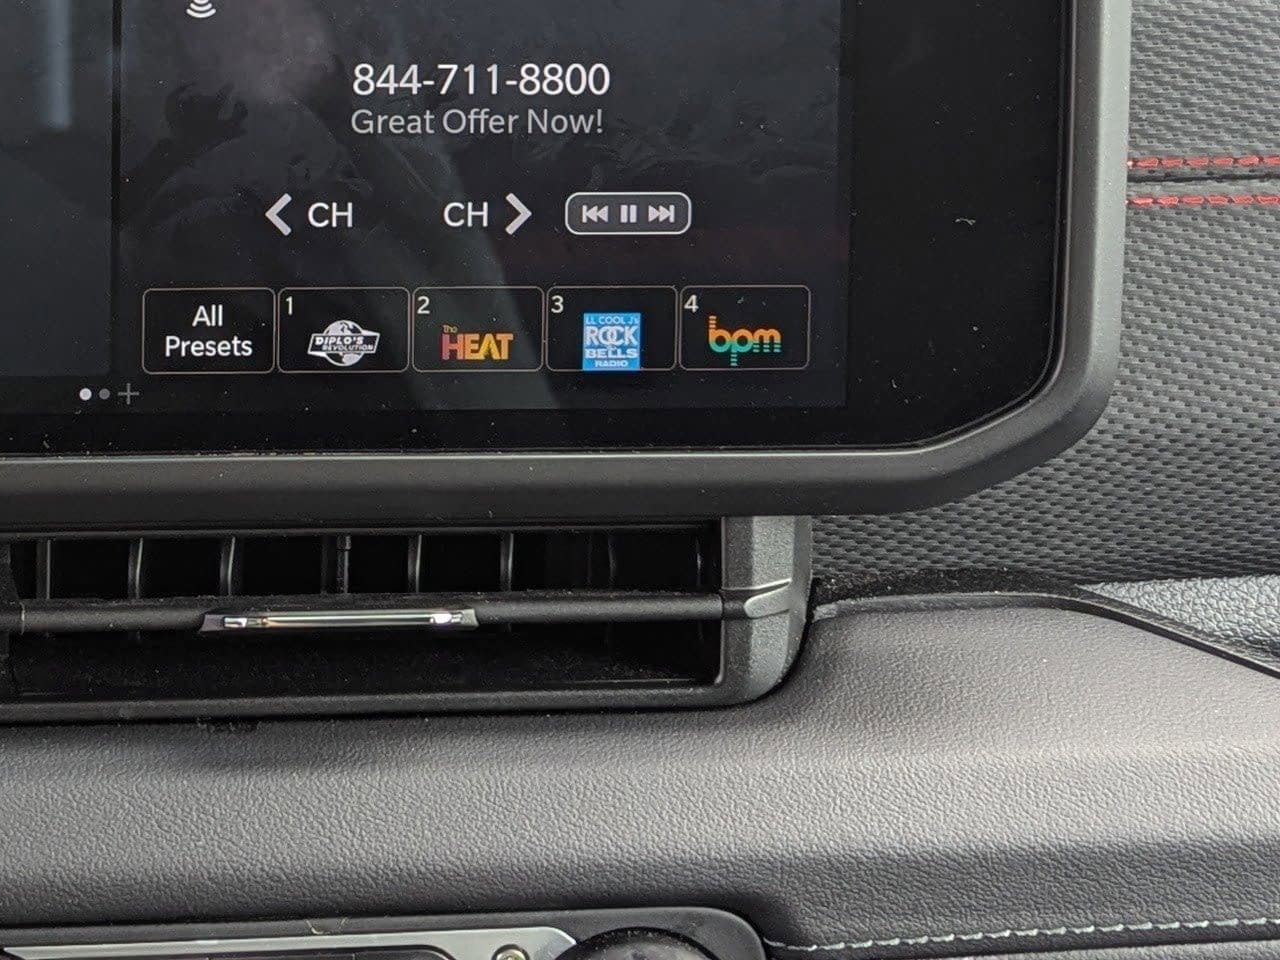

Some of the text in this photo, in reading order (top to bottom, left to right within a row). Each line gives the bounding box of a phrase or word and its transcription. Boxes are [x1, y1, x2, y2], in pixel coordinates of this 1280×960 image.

[352, 64, 610, 96] 844-711-8800
[351, 108, 603, 134] Great Offer Now!
[308, 203, 353, 227] CH
[444, 202, 488, 227] CH
[286, 298, 293, 314] 1
[417, 297, 430, 314] 2
[551, 296, 563, 313] 3
[684, 295, 698, 312] 4
[192, 305, 223, 326] All
[315, 337, 363, 345] DIPLO'S
[586, 326, 638, 345] ROCK
[708, 315, 782, 366] bpm
[165, 336, 252, 357] Presets
[442, 333, 513, 360] HEAT
[585, 348, 637, 358] BELLS
